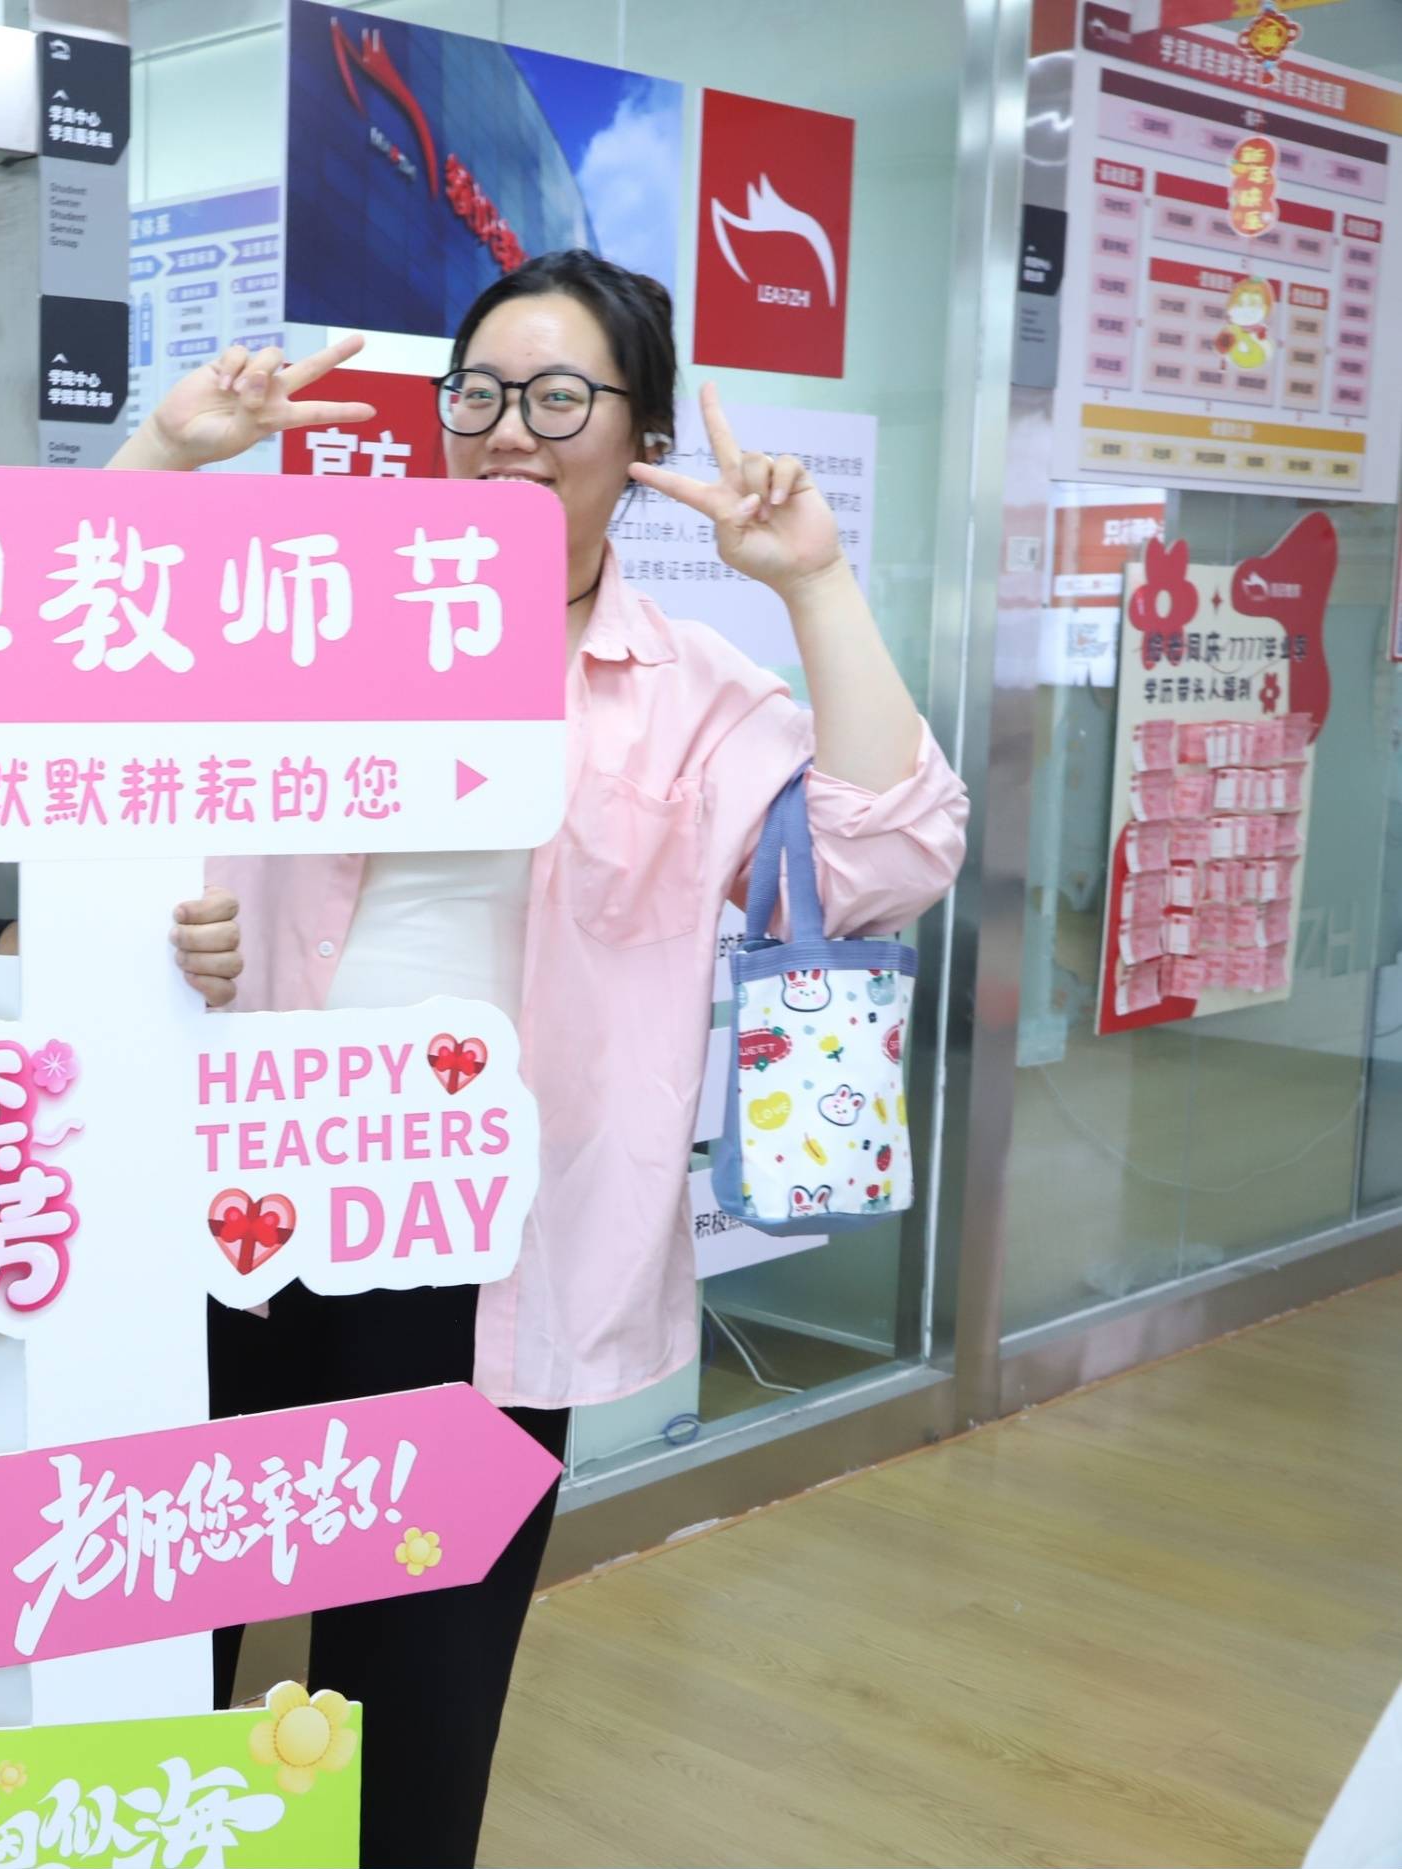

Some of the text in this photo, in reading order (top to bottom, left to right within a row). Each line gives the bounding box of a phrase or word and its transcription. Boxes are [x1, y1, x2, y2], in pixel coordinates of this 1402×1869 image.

[198, 1043, 414, 1105] HAPPY
[195, 1108, 510, 1172] TEACHERS
[330, 1175, 509, 1263] DAY
